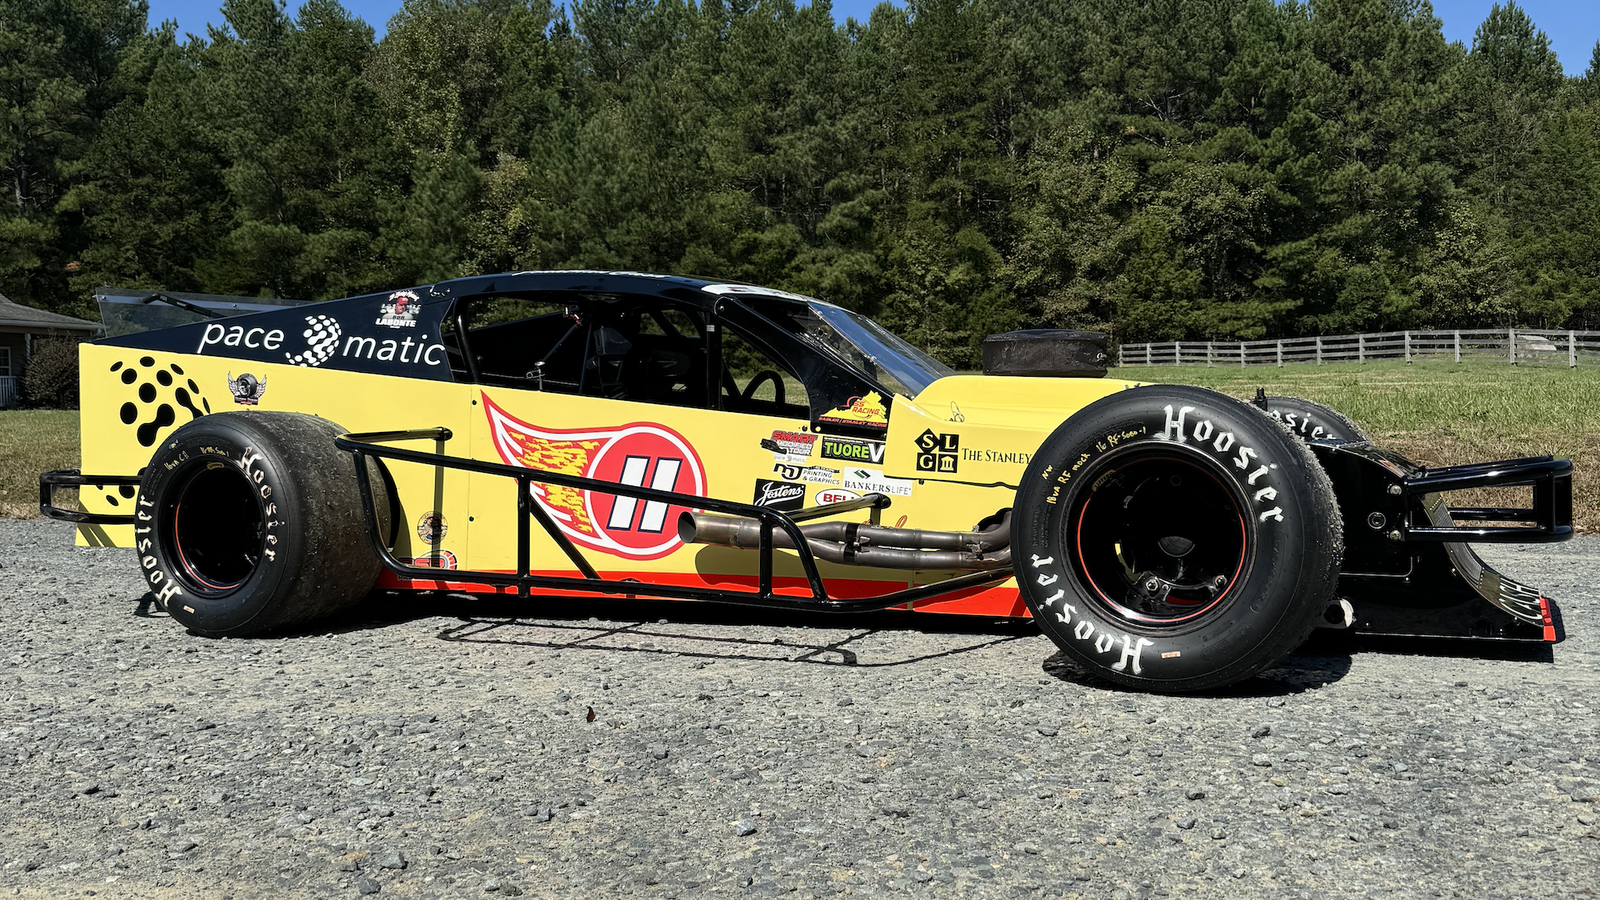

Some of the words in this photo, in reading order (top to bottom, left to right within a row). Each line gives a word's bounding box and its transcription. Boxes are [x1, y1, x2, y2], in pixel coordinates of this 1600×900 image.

[375, 318, 417, 327] LABONTE
[197, 323, 285, 355] pace
[342, 333, 446, 367] matic
[852, 406, 881, 415] RACING
[773, 431, 817, 444] SMART
[961, 448, 983, 461] THE
[985, 449, 1032, 465] STANLEY
[1153, 404, 1285, 525] Hoosier
[803, 470, 833, 478] PRINTING
[808, 476, 840, 485] GRAPHICS
[1057, 470, 1072, 484] RF
[237, 445, 286, 563] Hoosier
[607, 456, 683, 533] 11
[754, 482, 804, 507] Jostens
[134, 494, 183, 607] Hoosier
[1030, 552, 1155, 675] Hoosier
